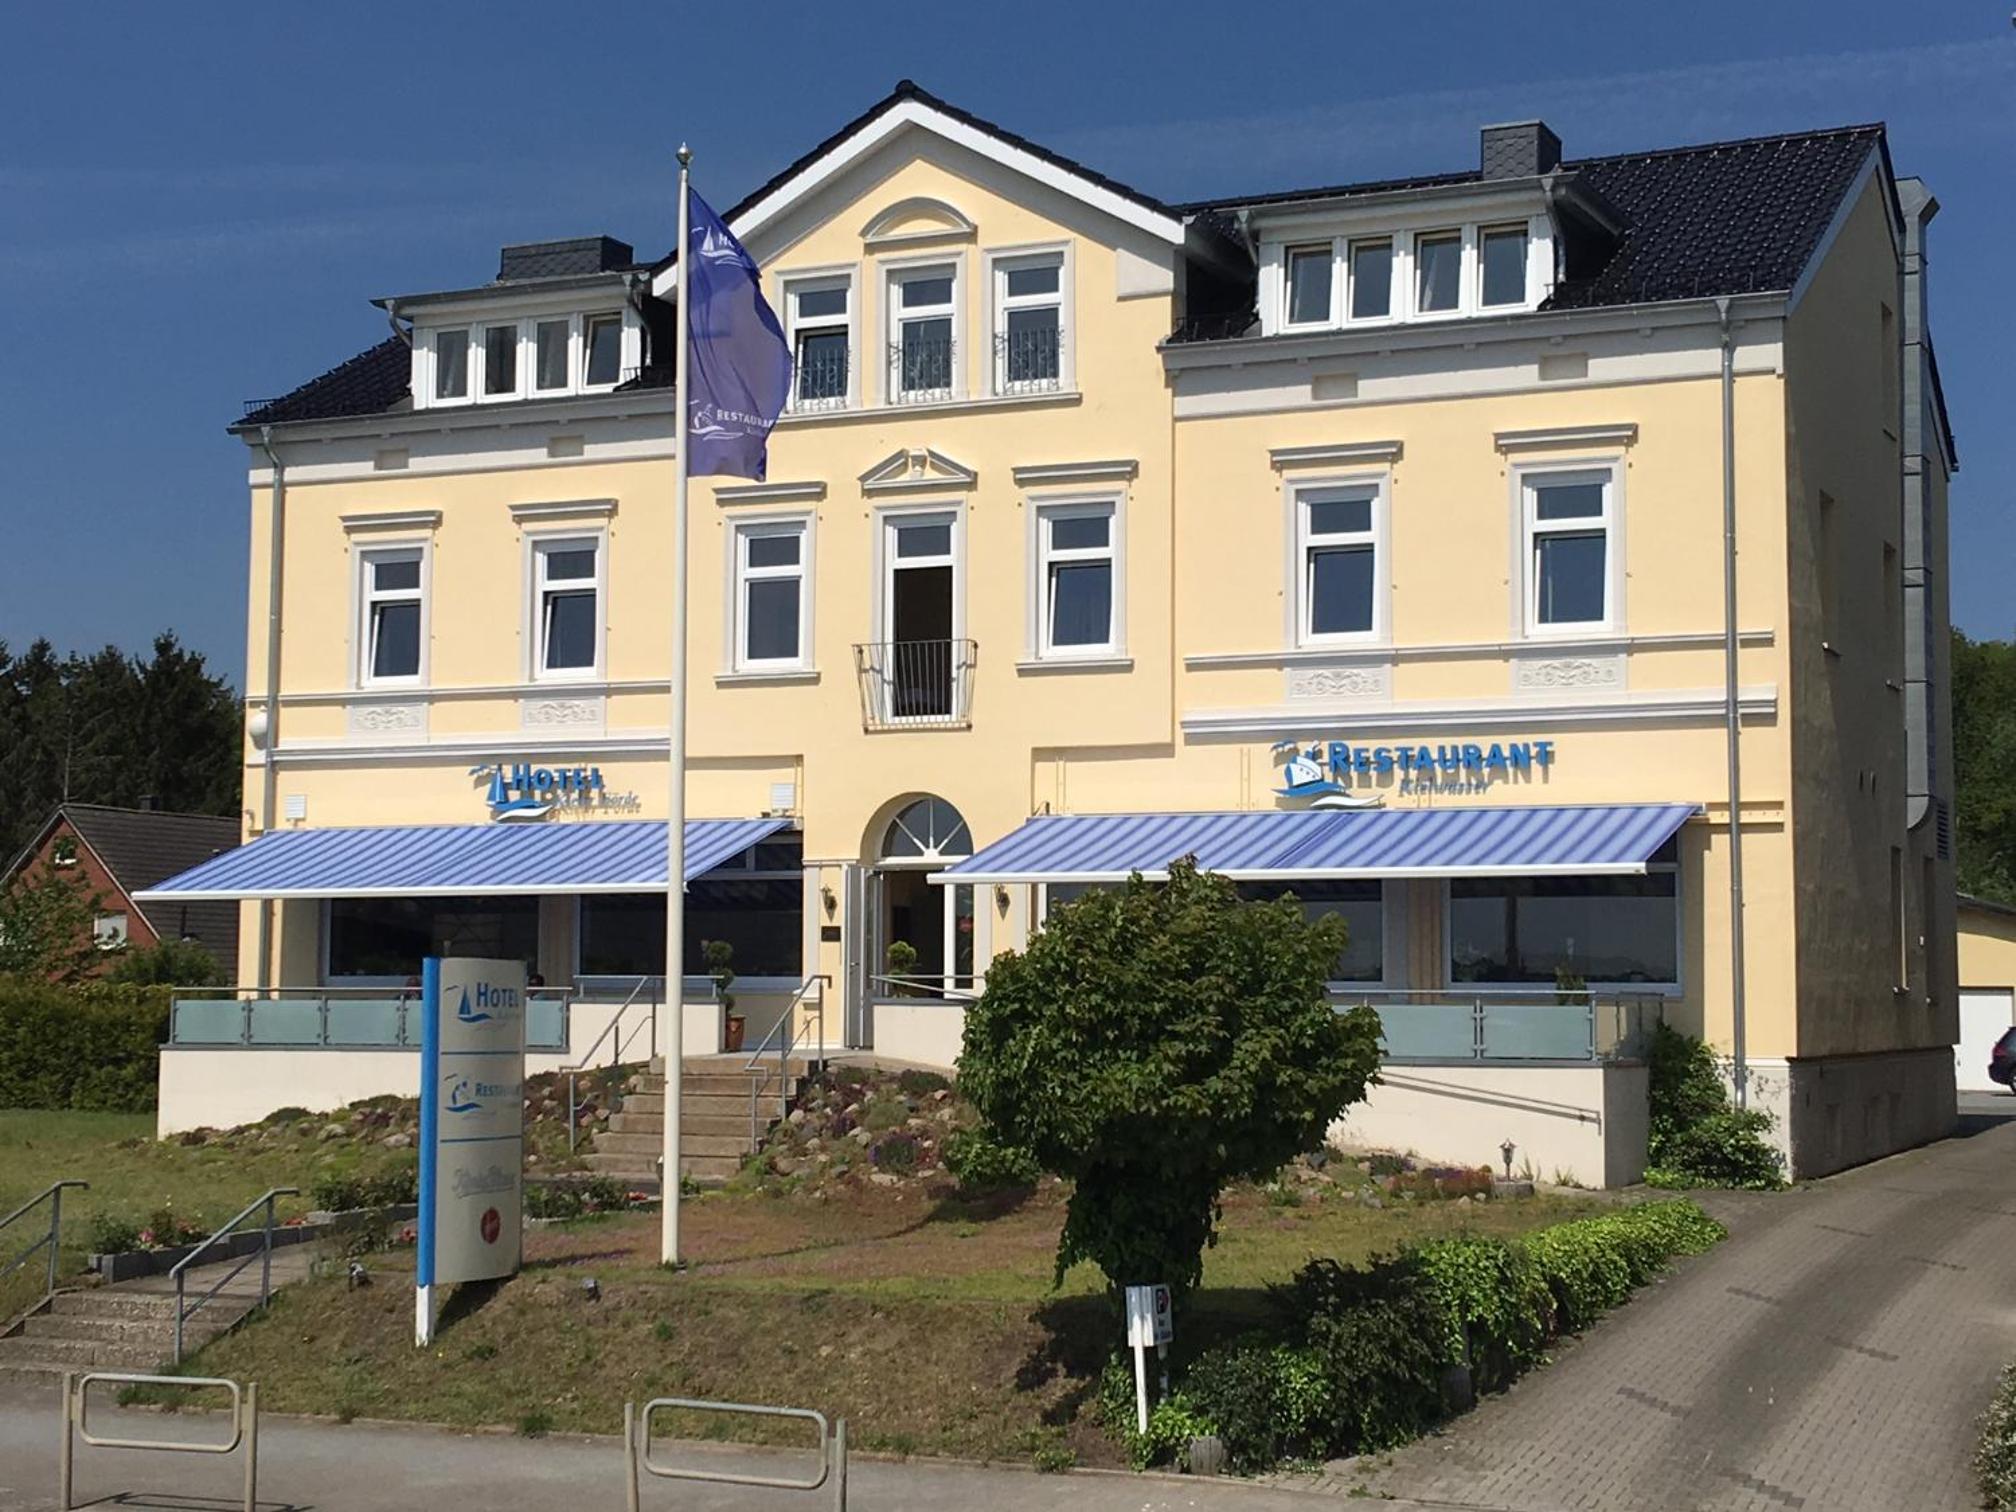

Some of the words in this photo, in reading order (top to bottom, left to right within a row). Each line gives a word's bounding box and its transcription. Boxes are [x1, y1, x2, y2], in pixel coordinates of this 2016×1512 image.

[1328, 740, 1554, 774] RESTAURANT
[511, 762, 601, 792] HOTEL
[475, 981, 519, 1008] HOTEL
